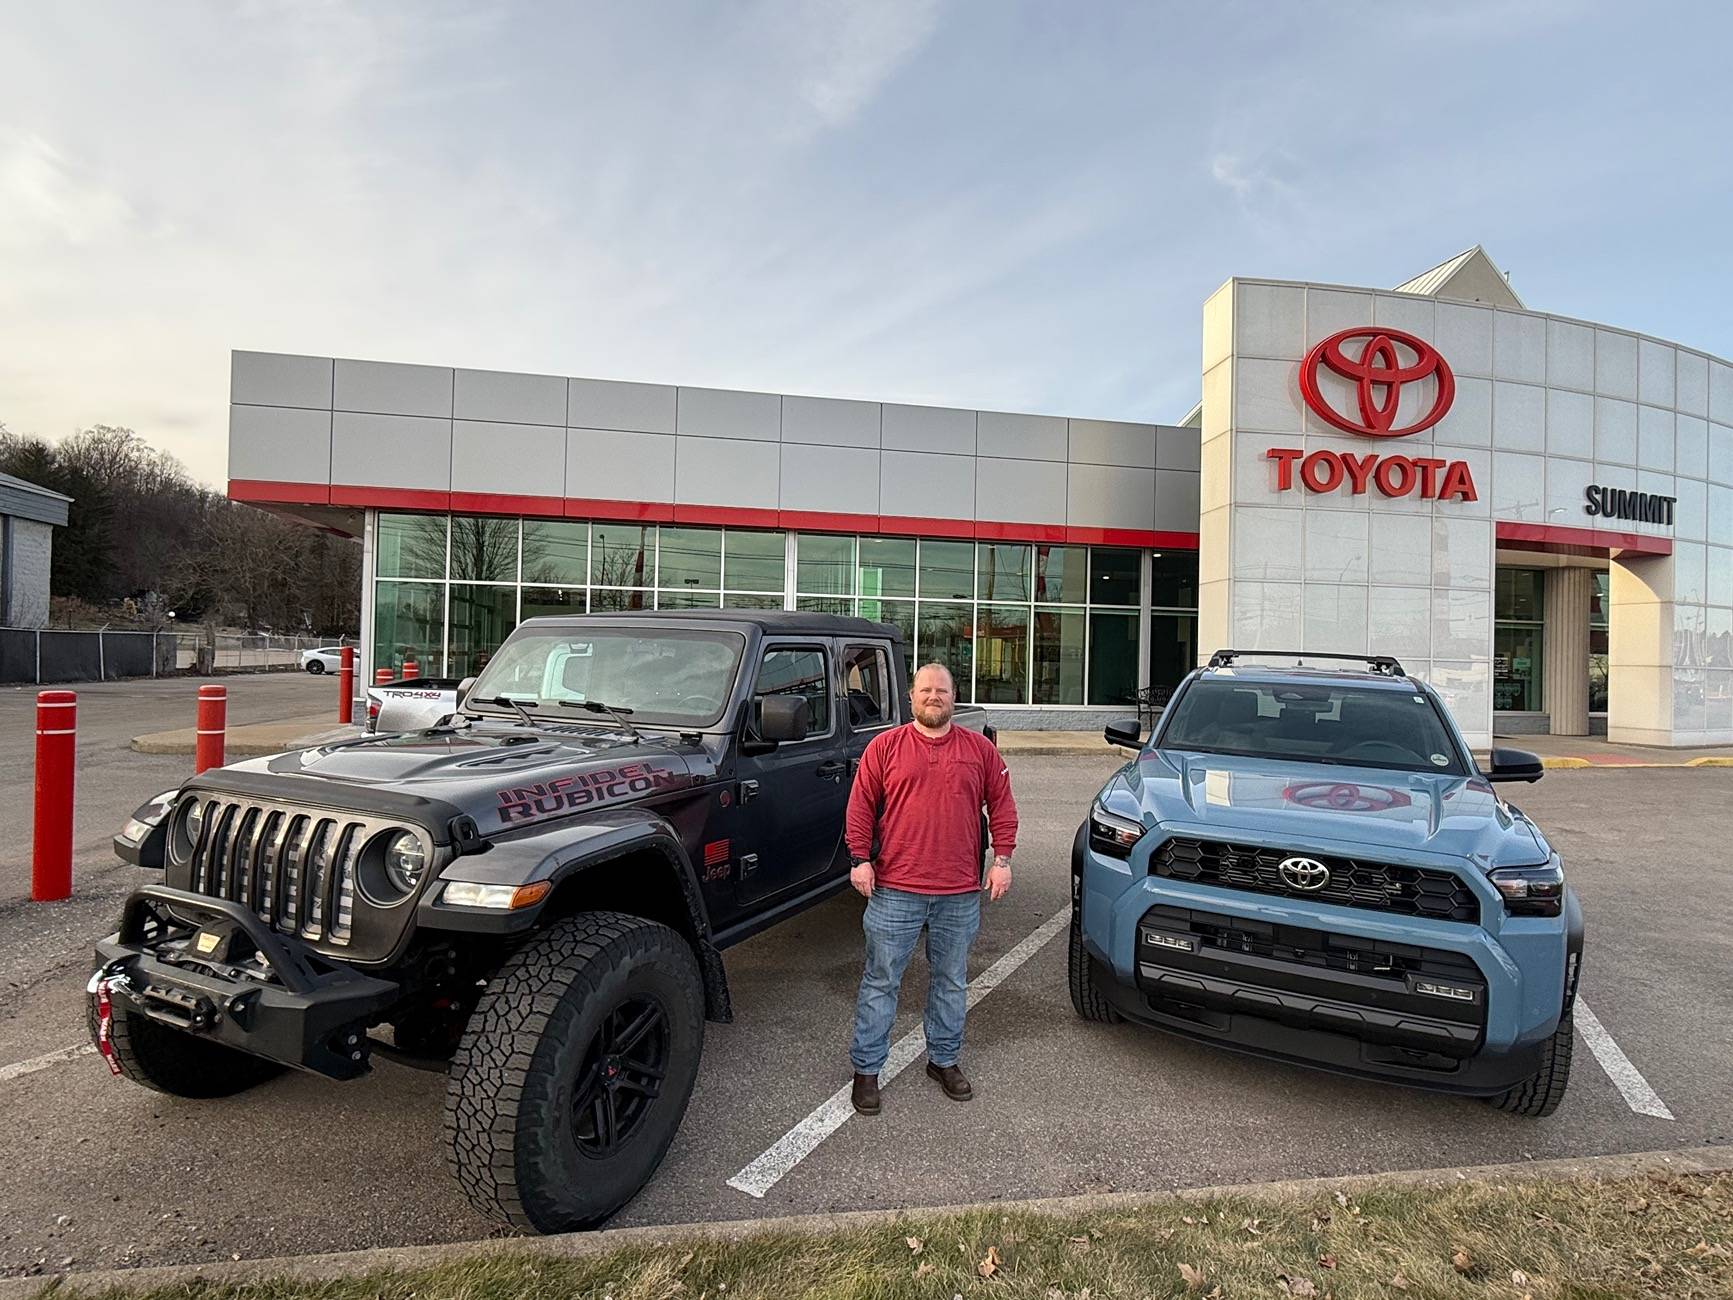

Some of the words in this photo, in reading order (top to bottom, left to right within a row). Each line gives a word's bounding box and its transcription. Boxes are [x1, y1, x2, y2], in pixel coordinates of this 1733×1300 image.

[1267, 448, 1478, 501] TOYOTA
[1585, 485, 1677, 525] SUMMIT
[497, 763, 666, 804] INFIDEL
[497, 771, 676, 823] RUBICON
[702, 864, 731, 882] Jeep
